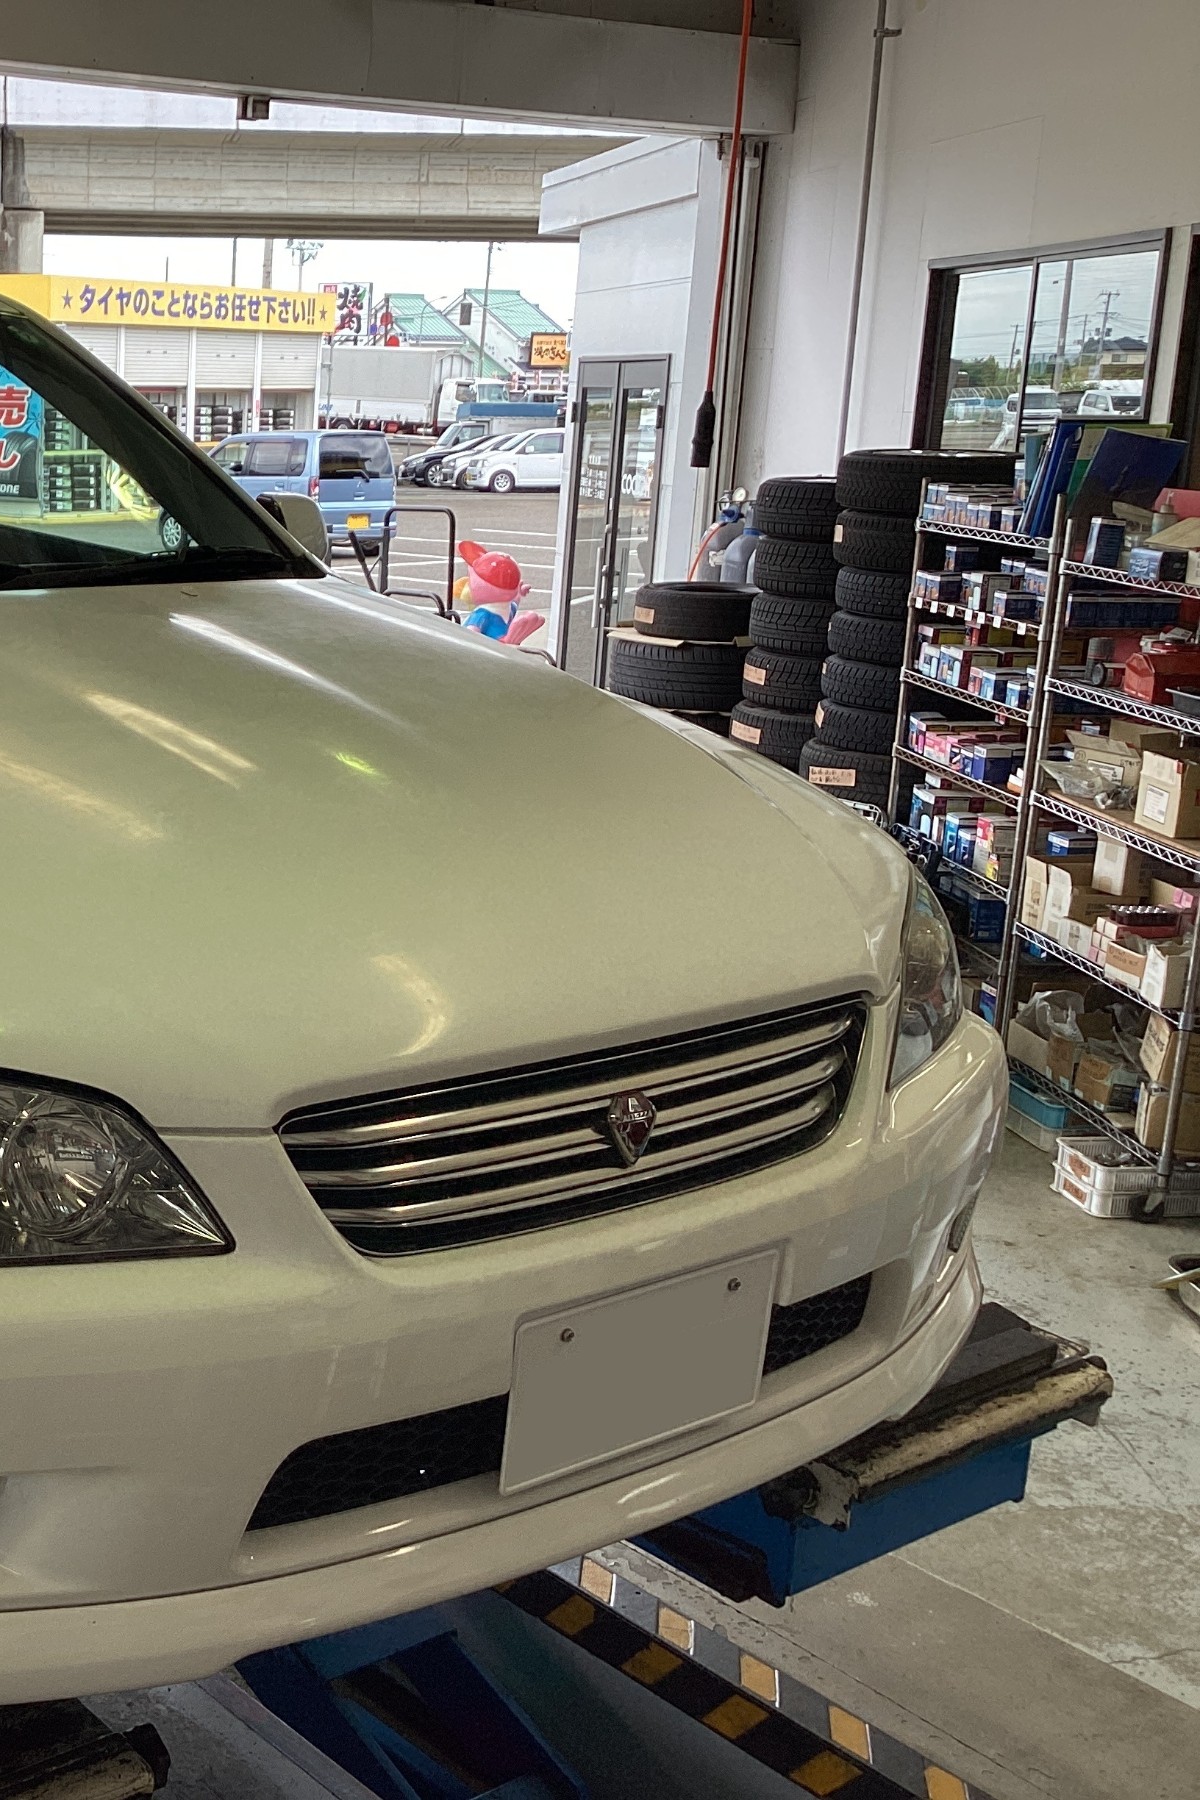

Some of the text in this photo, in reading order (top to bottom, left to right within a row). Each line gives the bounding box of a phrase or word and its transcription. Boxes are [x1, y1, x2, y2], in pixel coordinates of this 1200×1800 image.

[79, 284, 316, 325] タイヤのことならお任せ下さい!!
